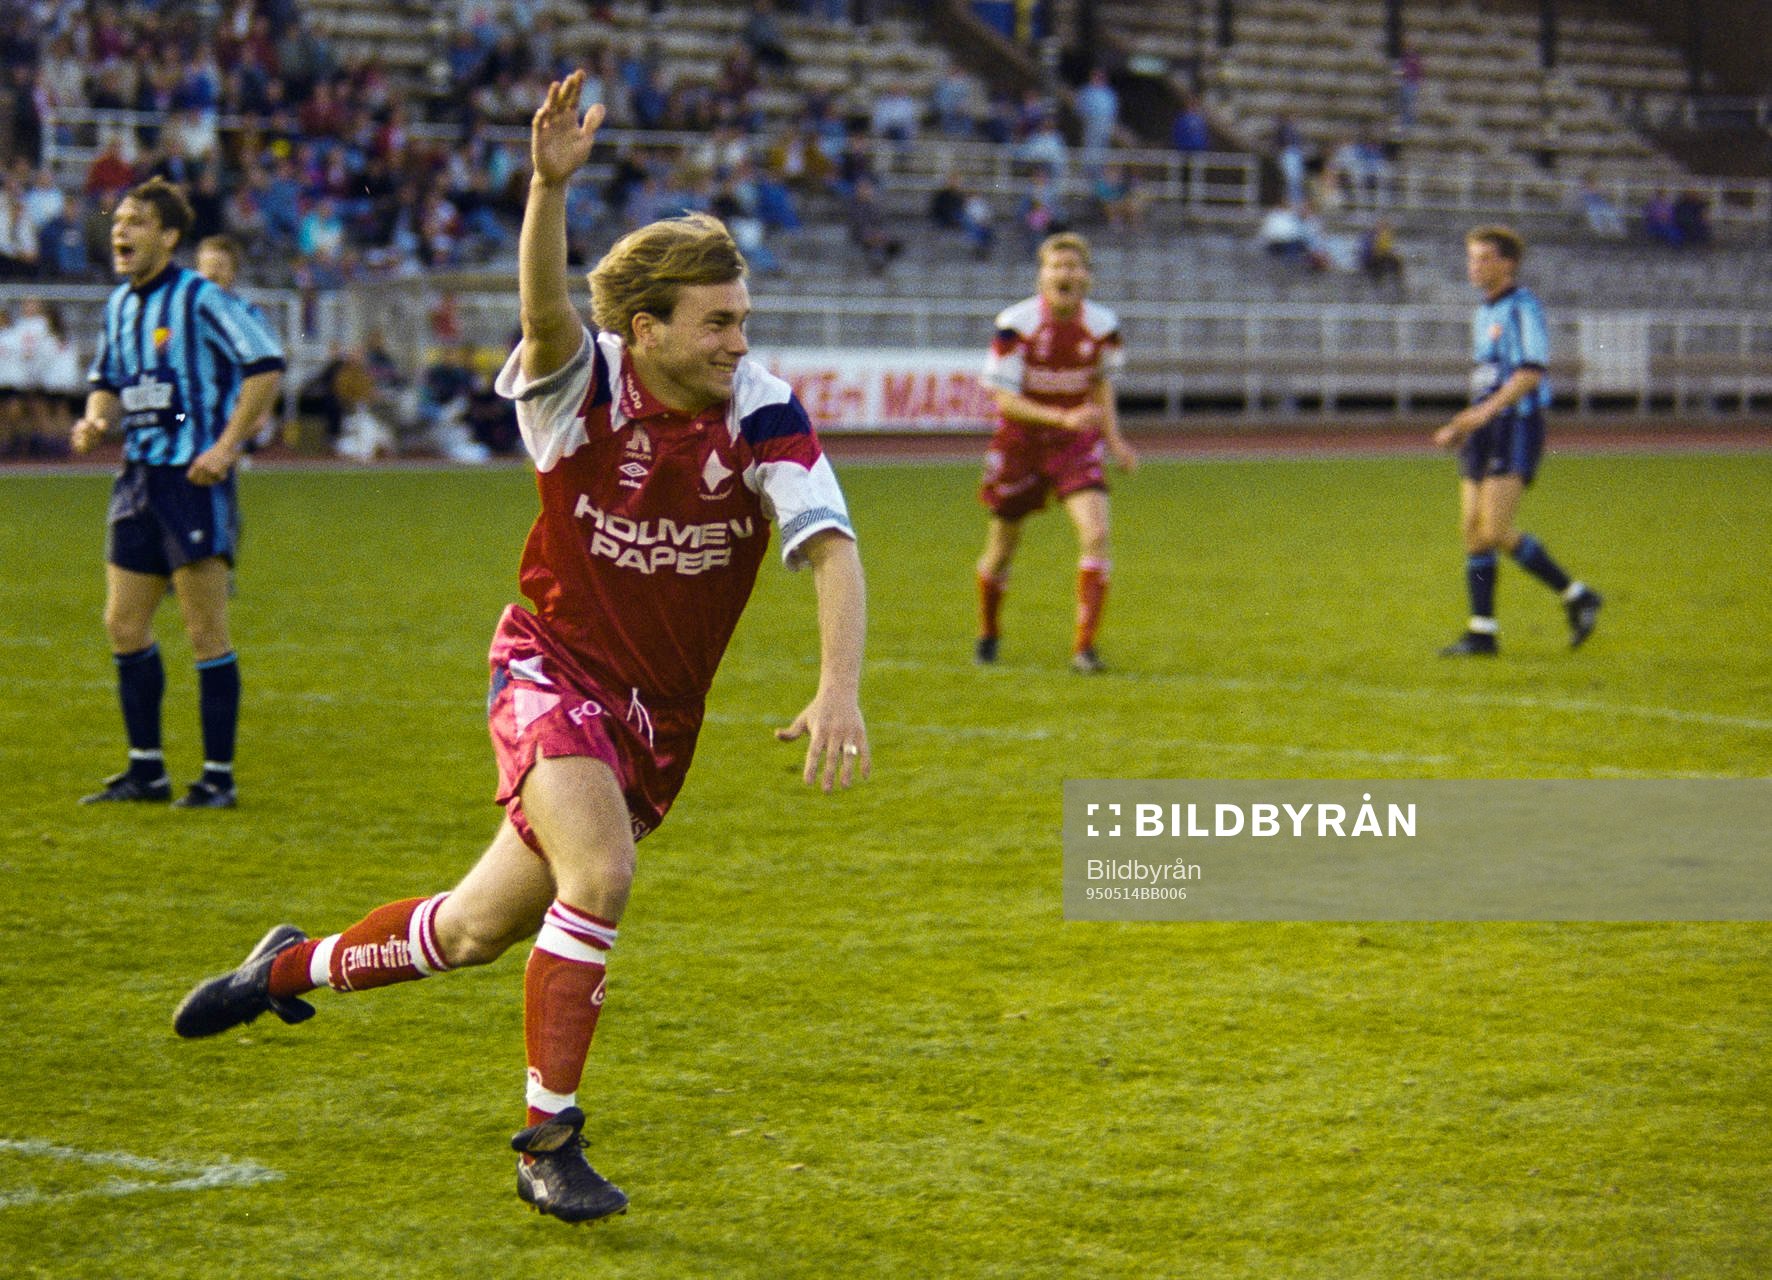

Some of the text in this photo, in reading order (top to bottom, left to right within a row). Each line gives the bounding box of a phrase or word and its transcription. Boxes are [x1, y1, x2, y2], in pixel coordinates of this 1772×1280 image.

[573, 493, 754, 549] HOLMEN
[590, 532, 732, 576] PAPER
[345, 943, 380, 972] LINE
